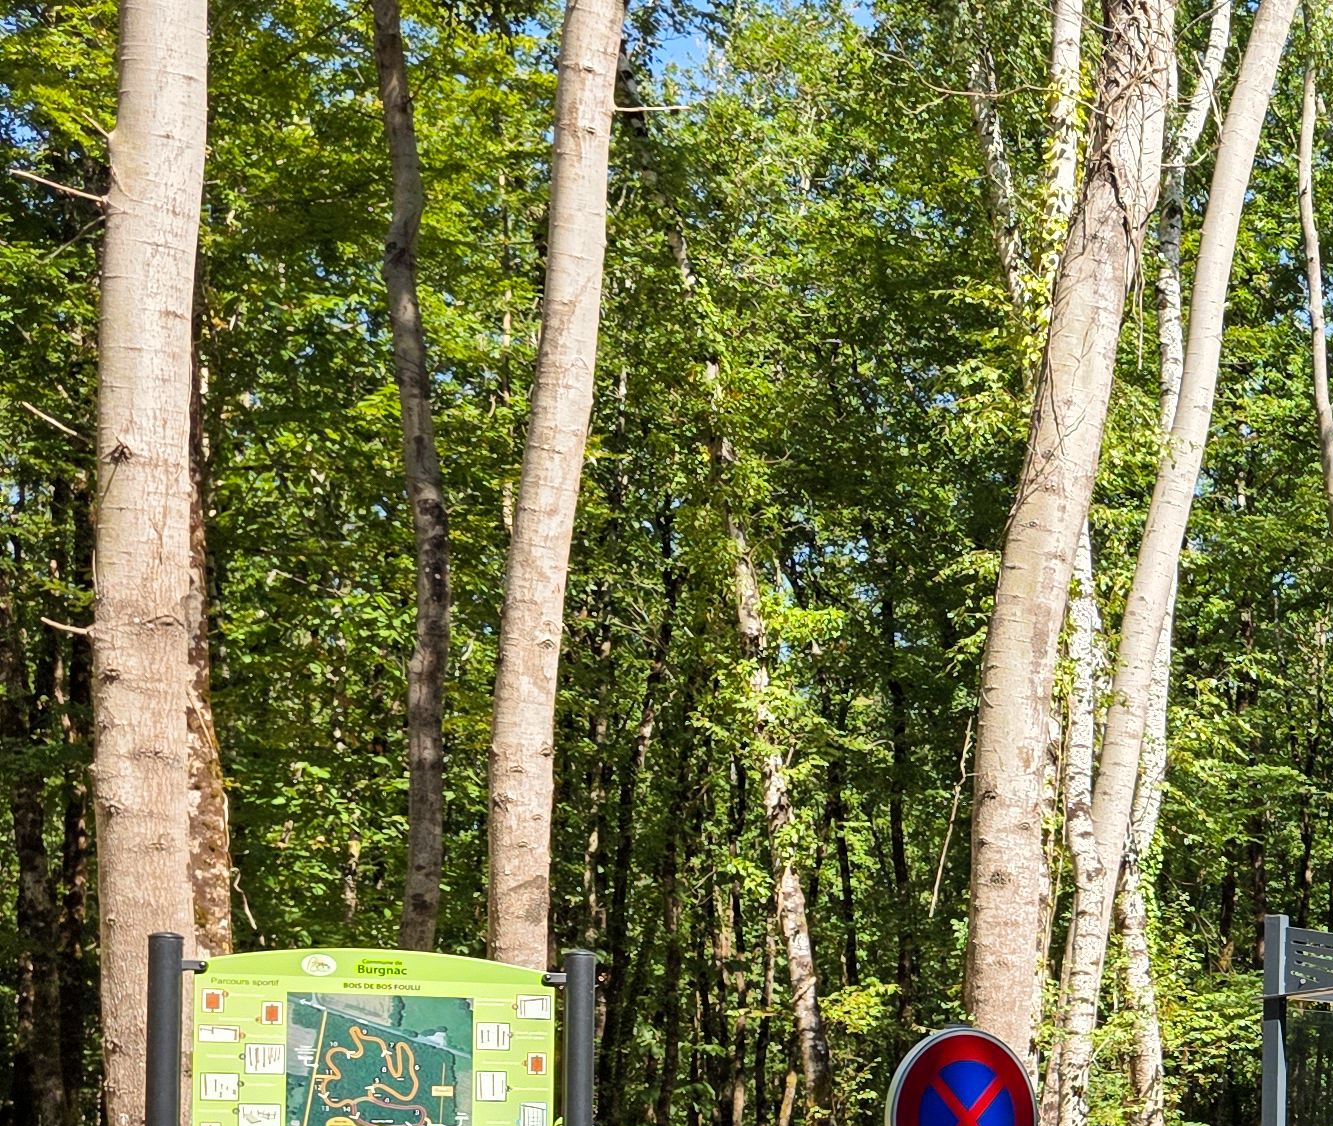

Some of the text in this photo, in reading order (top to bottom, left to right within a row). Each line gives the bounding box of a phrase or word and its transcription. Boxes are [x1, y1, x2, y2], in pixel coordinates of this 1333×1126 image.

[357, 964, 408, 977] Burgnac
[210, 976, 280, 987] Parcours sportif
